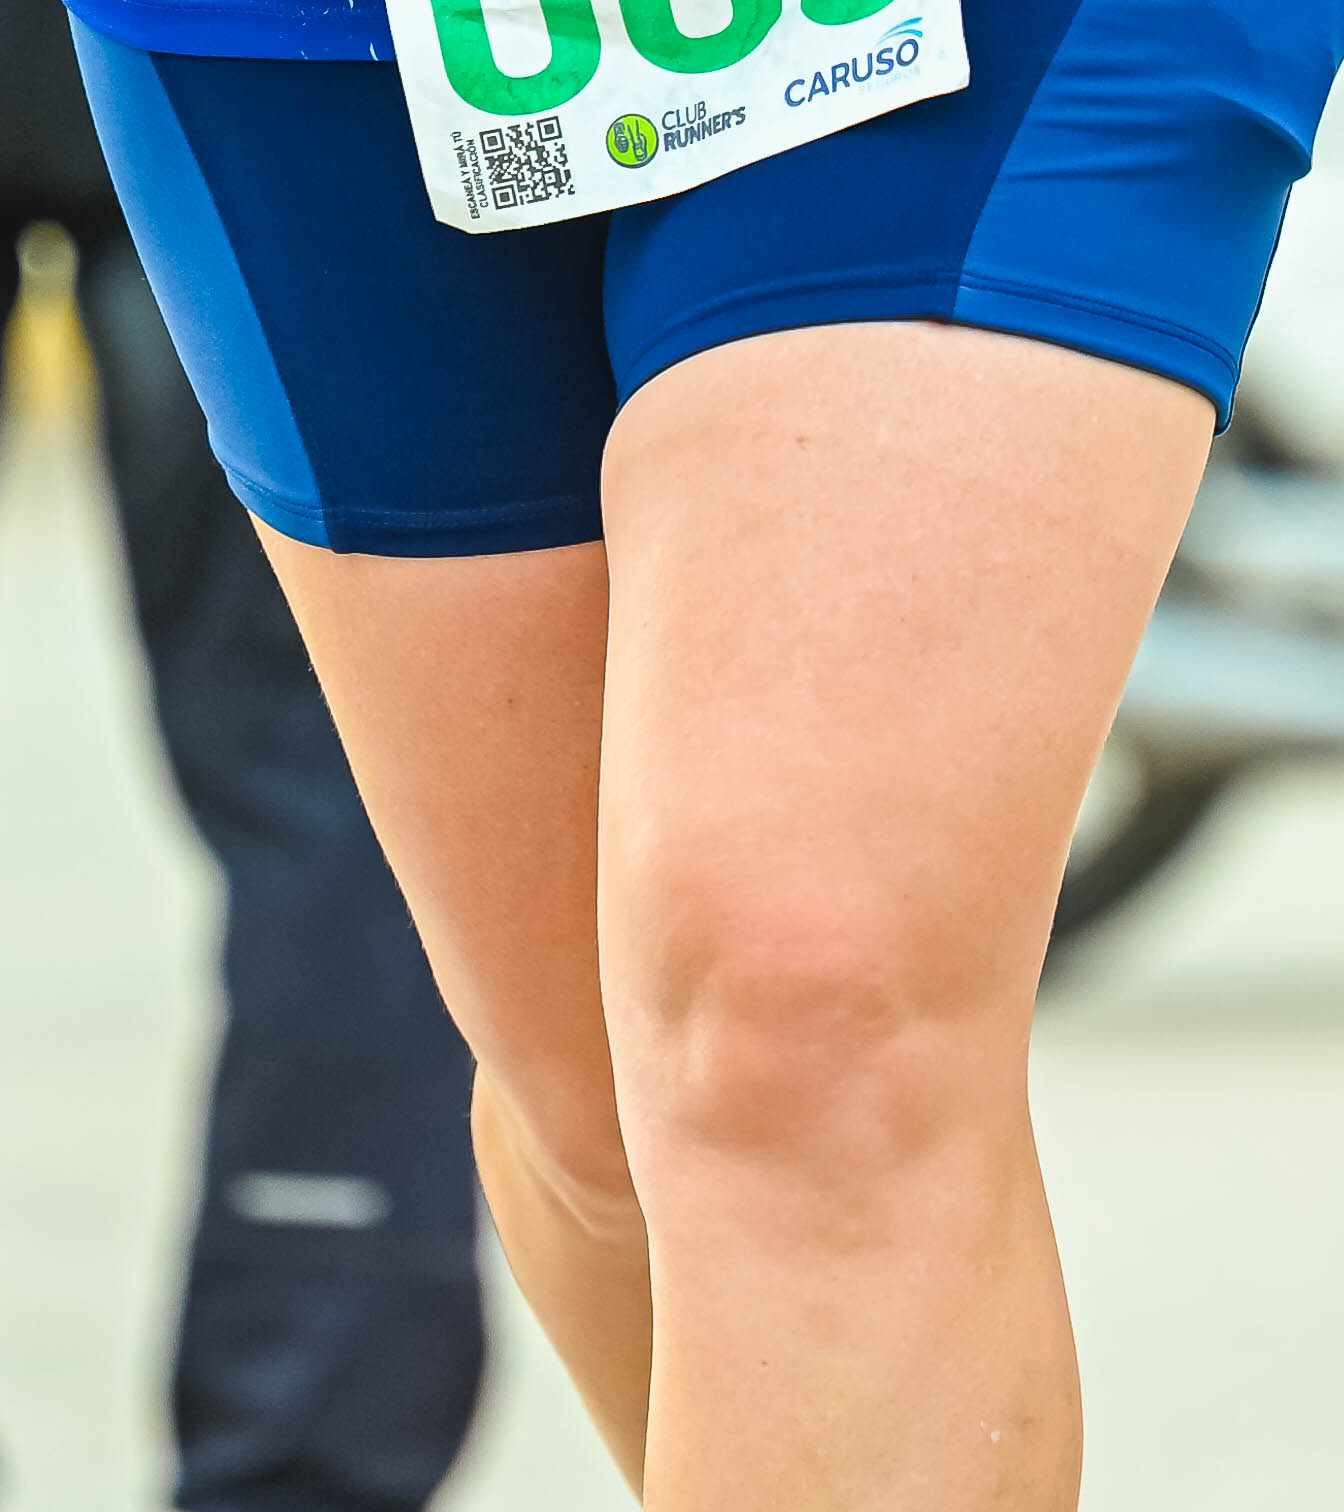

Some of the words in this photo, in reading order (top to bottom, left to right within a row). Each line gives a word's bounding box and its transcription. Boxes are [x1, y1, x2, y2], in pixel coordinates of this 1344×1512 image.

[784, 38, 919, 107] CARUSO
[662, 101, 707, 130] CLUB
[663, 106, 746, 152] RUNNER'S
